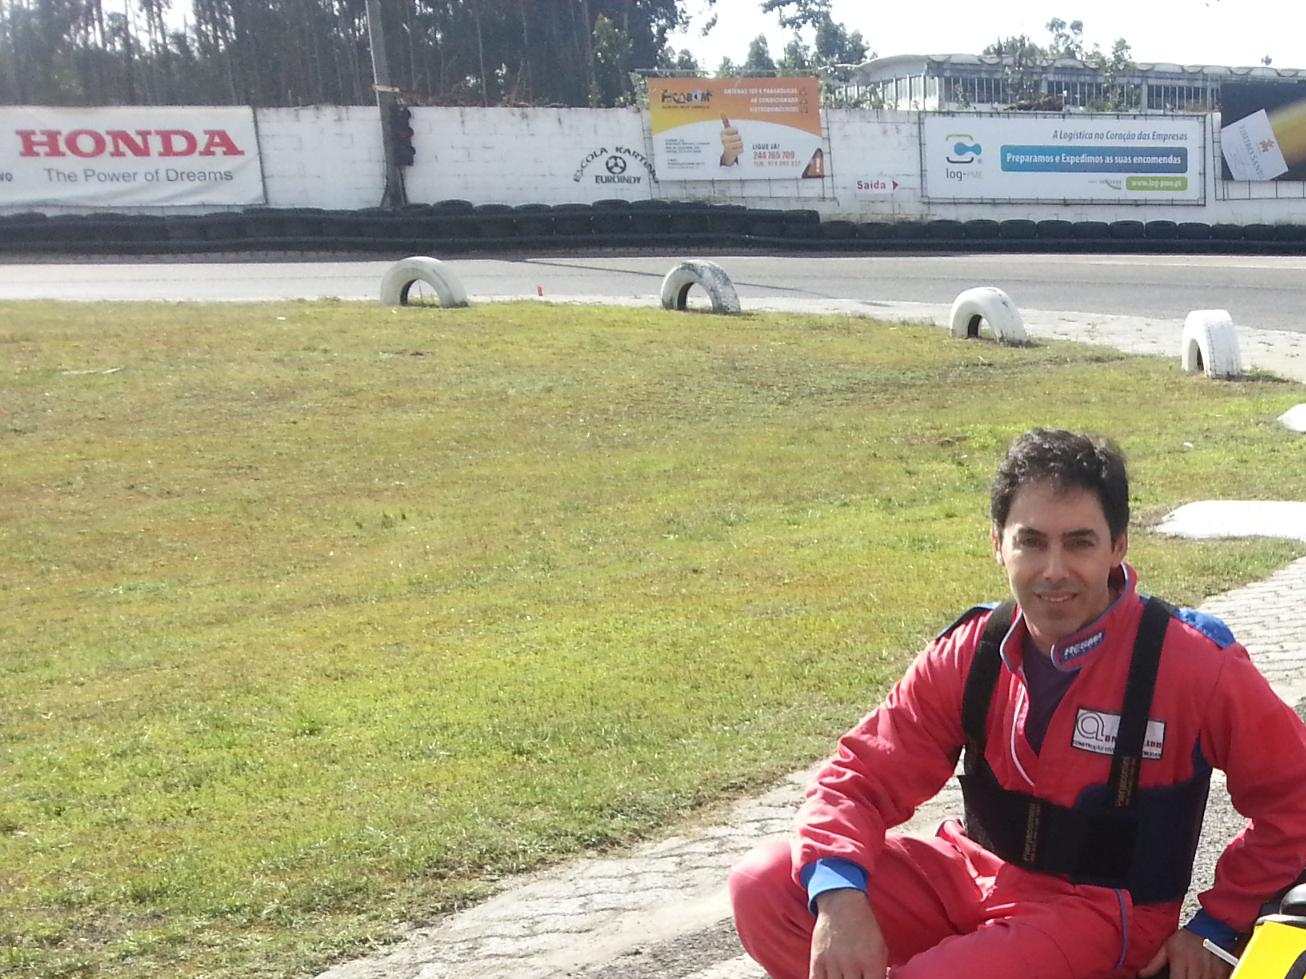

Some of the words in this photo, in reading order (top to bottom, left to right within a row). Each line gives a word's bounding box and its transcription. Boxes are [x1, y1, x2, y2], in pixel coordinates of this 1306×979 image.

[16, 129, 245, 158] HONDA
[1137, 131, 1150, 140] das
[1151, 131, 1188, 143] Empresas
[573, 147, 608, 183] ESCOLA
[1006, 152, 1054, 165] Preparamos
[1054, 155, 1060, 163] e
[1061, 152, 1103, 165] Expedimos
[1104, 155, 1113, 163] as
[1114, 155, 1132, 164] suas
[1132, 154, 1181, 164] encomendas
[44, 168, 78, 183] The
[84, 168, 137, 183] Power
[144, 168, 161, 183] of
[166, 168, 234, 182] Dreams
[594, 175, 641, 184] EUROINDY
